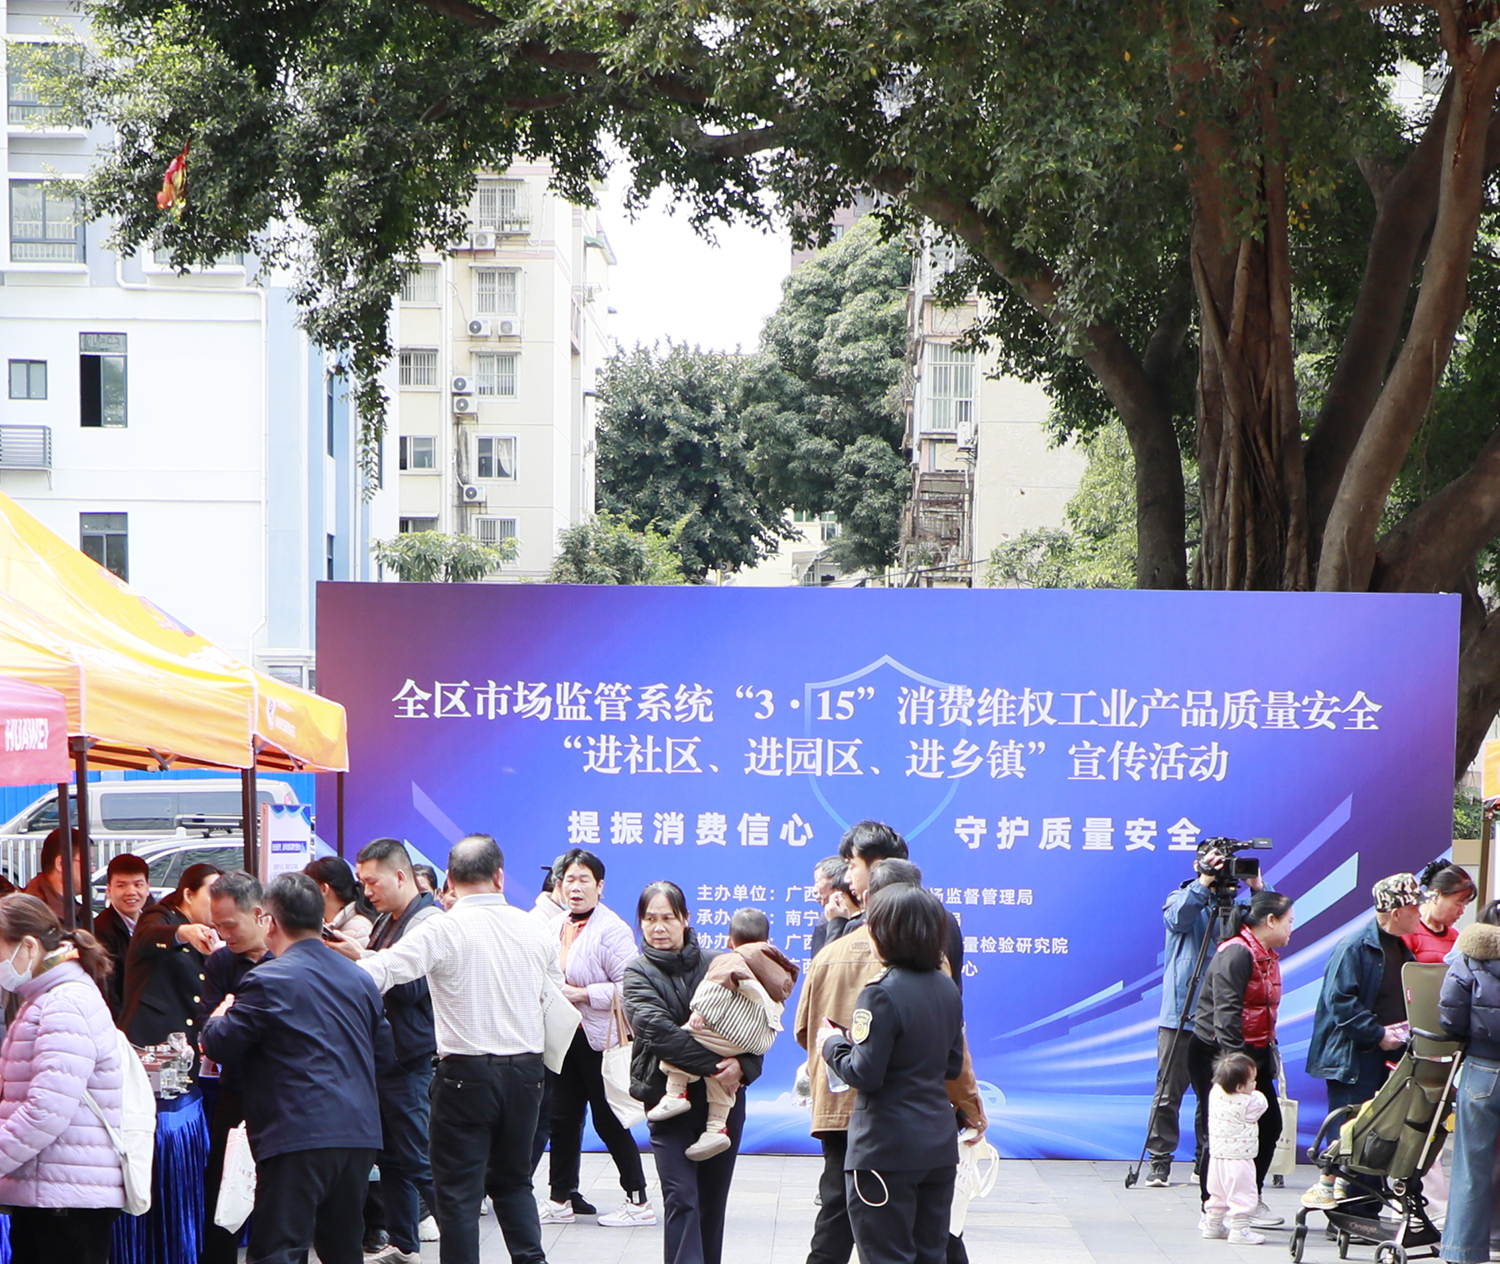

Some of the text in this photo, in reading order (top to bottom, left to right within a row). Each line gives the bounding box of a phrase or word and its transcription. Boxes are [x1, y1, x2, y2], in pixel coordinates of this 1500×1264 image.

[5, 717, 49, 752] HUAWEI
[567, 810, 1202, 851] 提振消费信心 守护质量安全
